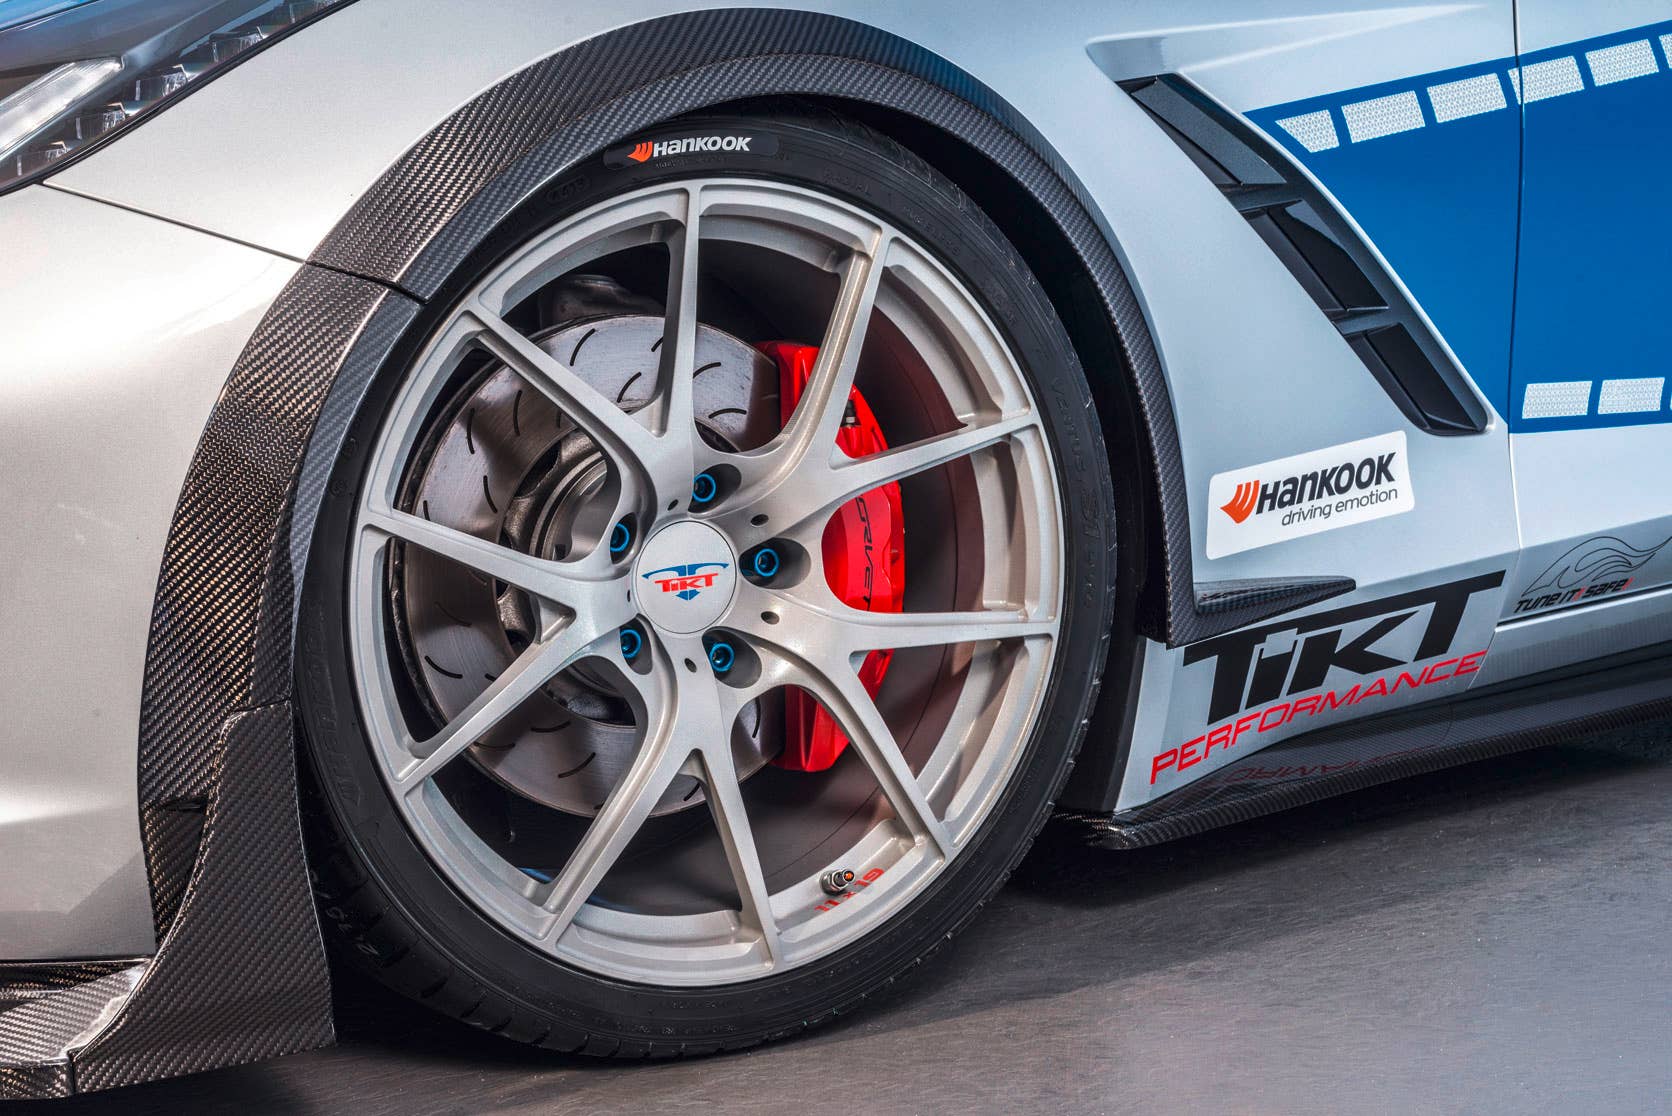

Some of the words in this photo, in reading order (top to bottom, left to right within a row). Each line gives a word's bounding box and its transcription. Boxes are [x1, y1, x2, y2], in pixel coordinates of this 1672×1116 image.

[1281, 502, 1332, 526] driving
[1336, 488, 1398, 513] emotion
[1149, 650, 1488, 785] PERFORMANCE
